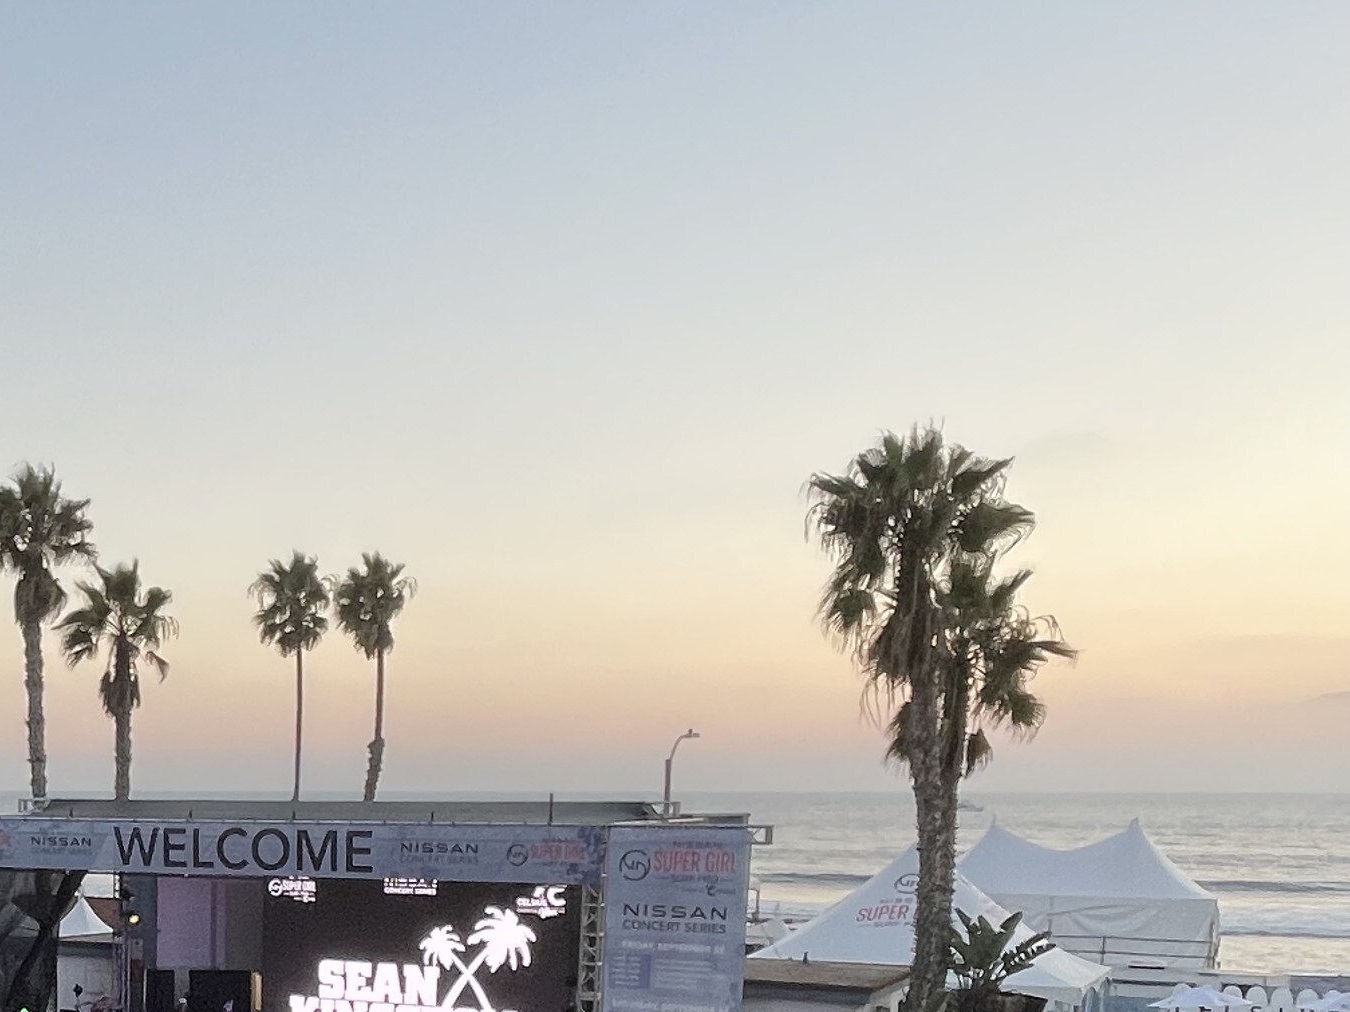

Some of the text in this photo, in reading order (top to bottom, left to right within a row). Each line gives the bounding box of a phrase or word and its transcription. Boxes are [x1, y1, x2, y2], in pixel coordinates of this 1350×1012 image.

[30, 836, 92, 847] NISSAN
[113, 826, 374, 873] WELCOME
[400, 842, 479, 854] NISSAN
[653, 850, 736, 873] SUPER GIRL
[622, 904, 728, 921] NISSAN
[856, 905, 910, 922] SUPER
[622, 920, 727, 934] CONCERT SERIES
[317, 958, 442, 1007] SEAN
